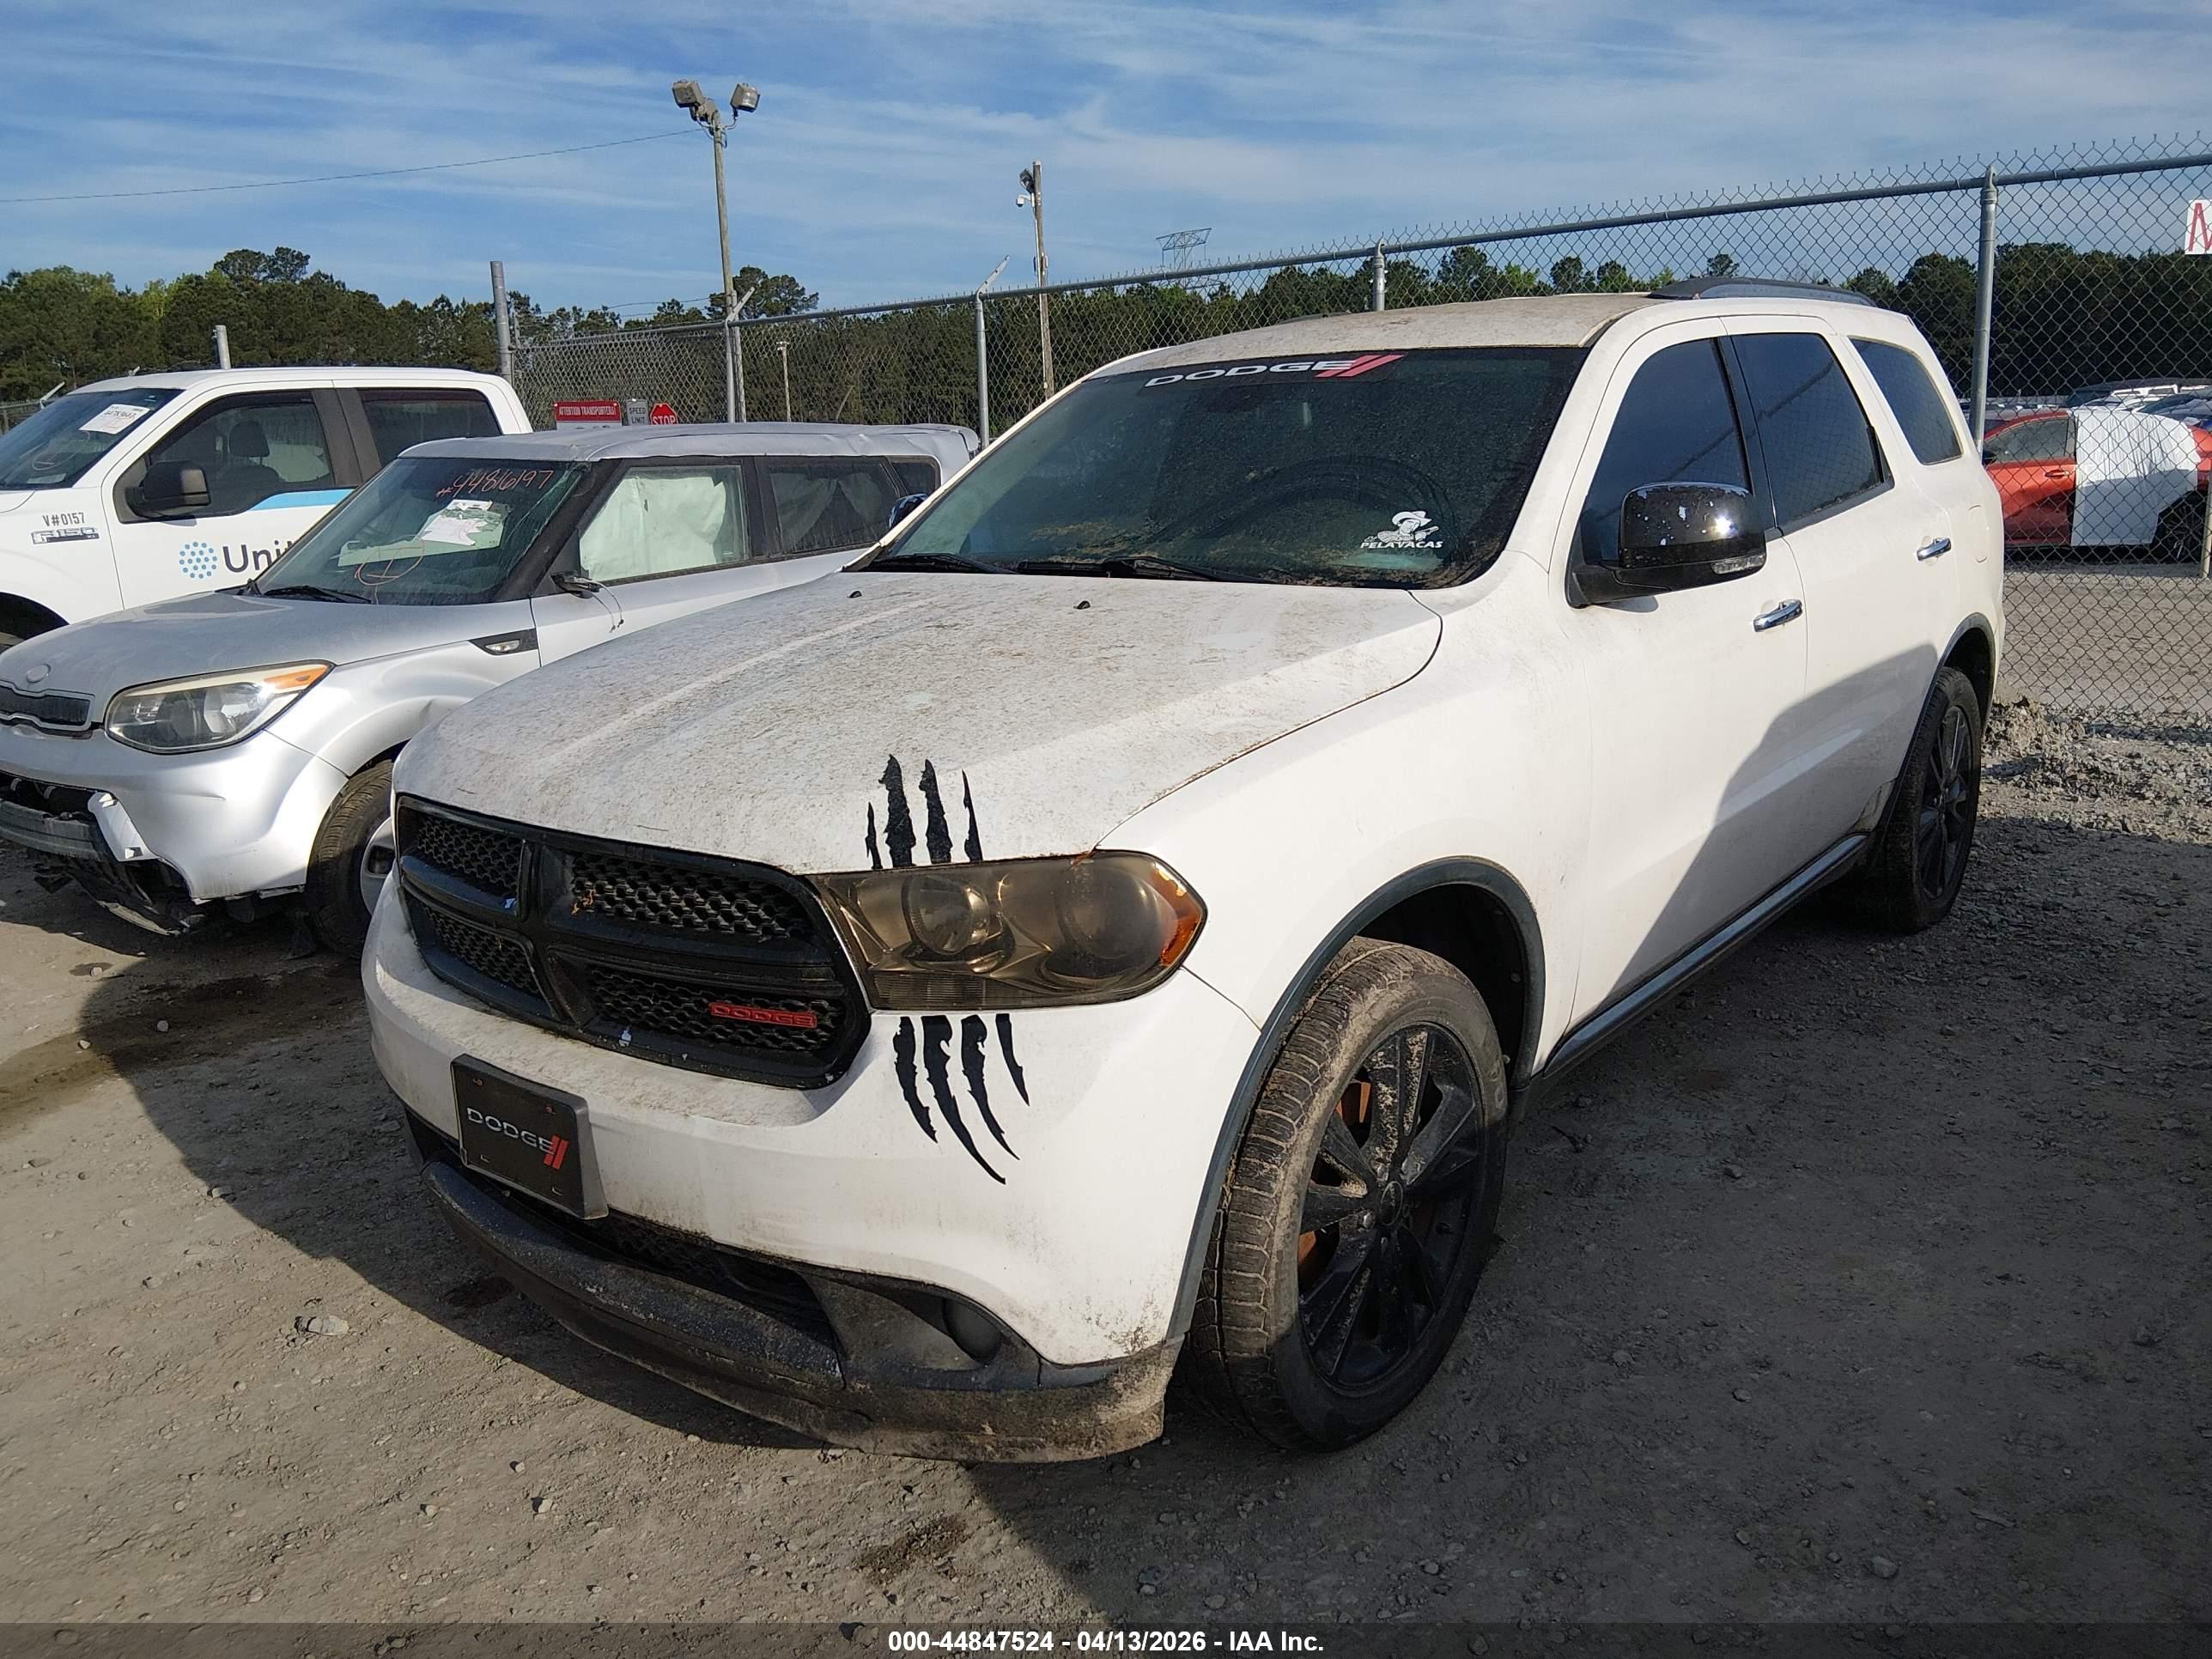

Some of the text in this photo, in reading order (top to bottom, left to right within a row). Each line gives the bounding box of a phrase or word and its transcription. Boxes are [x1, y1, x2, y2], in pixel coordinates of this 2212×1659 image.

[1145, 361, 1357, 386] DODGE
[559, 406, 580, 416] ATTENTION
[653, 415, 677, 426] STOP
[42, 512, 85, 526] V#0157
[712, 1005, 814, 1027] DODGE
[466, 1107, 555, 1155] DODGE
